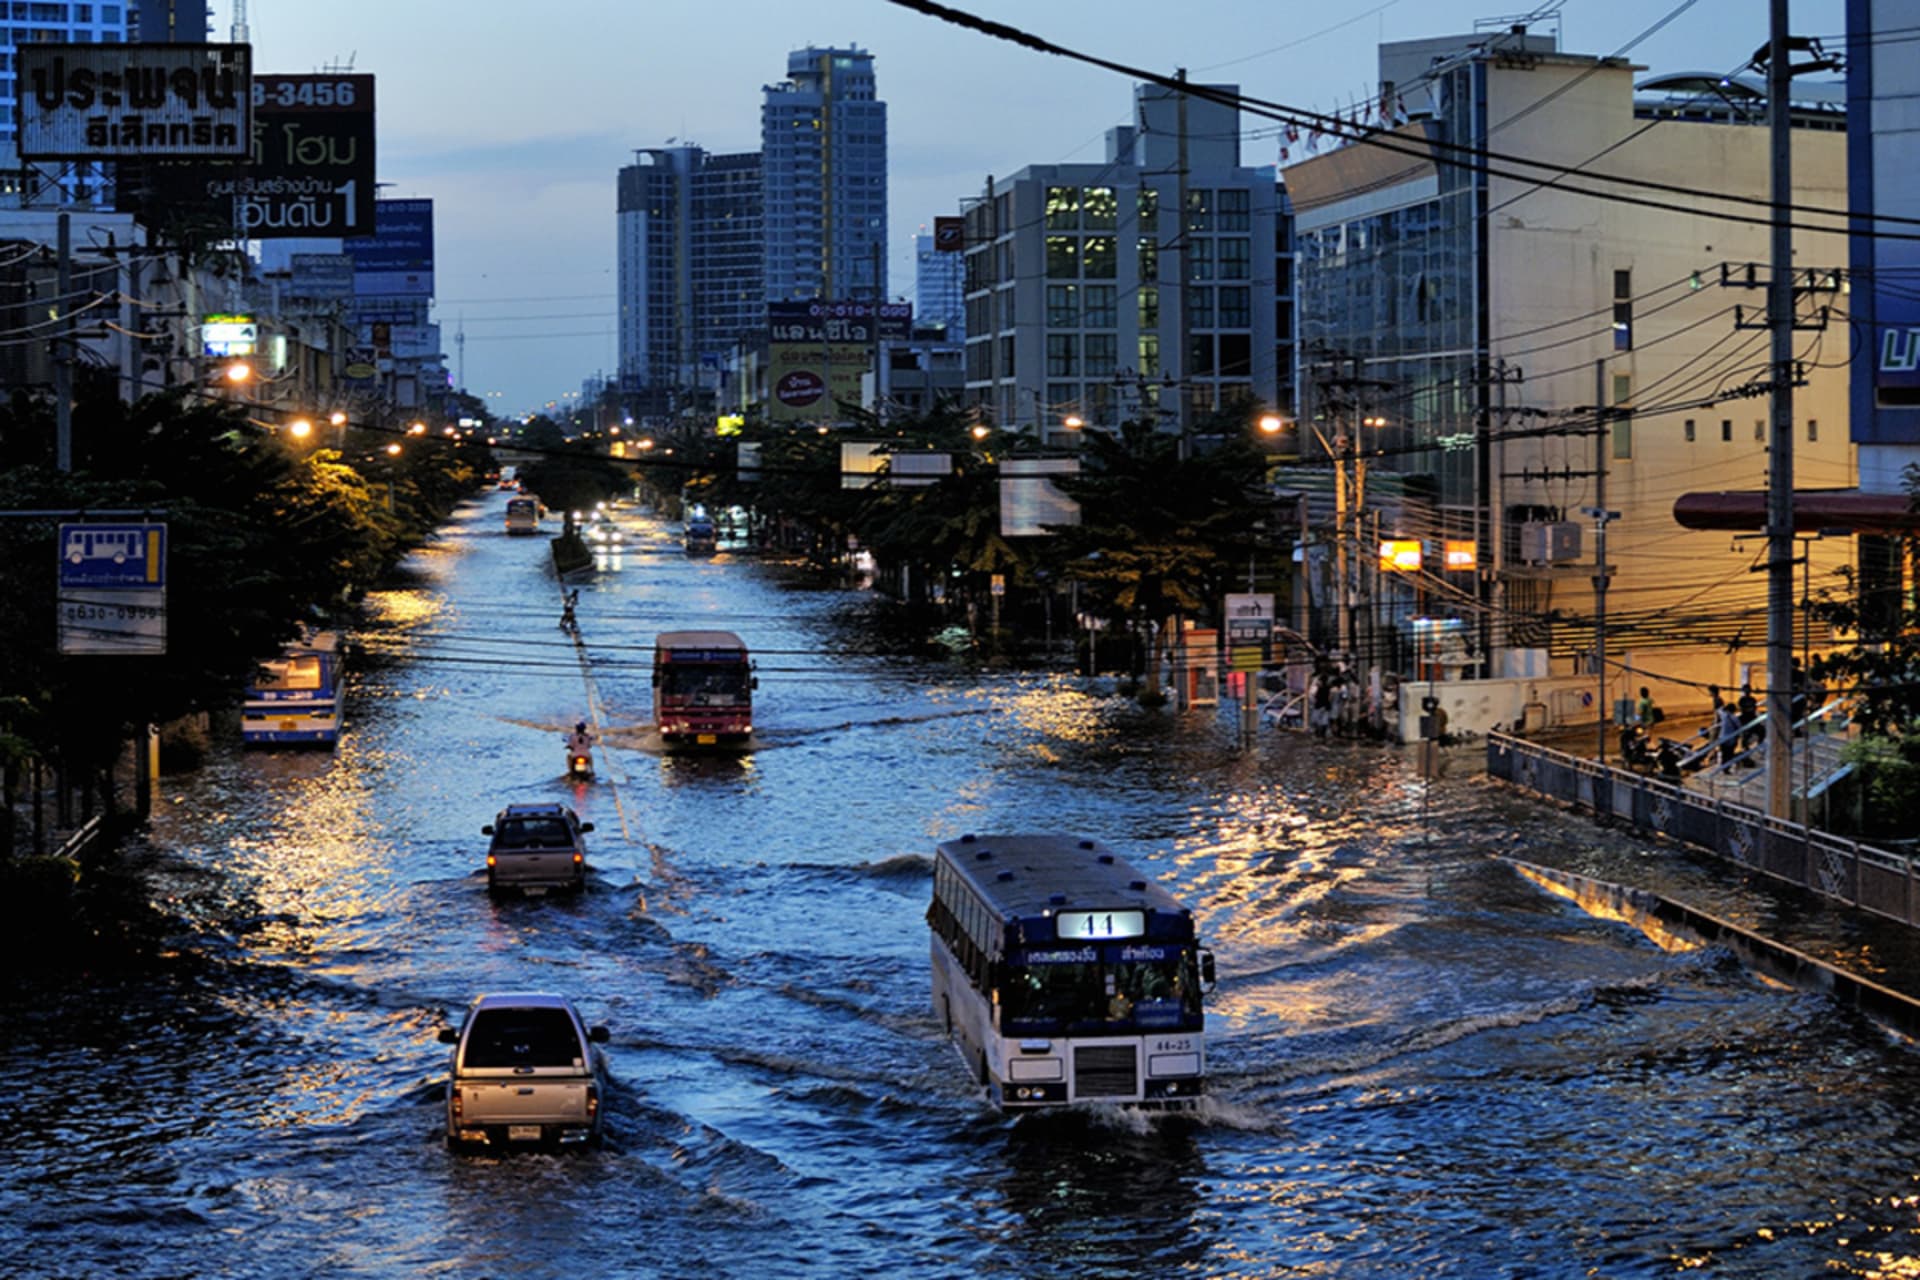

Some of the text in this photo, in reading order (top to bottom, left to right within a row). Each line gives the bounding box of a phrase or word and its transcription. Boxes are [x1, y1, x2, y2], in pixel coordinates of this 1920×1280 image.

[242, 178, 358, 228] อันดับ 1
[1080, 913, 1114, 936] 44
